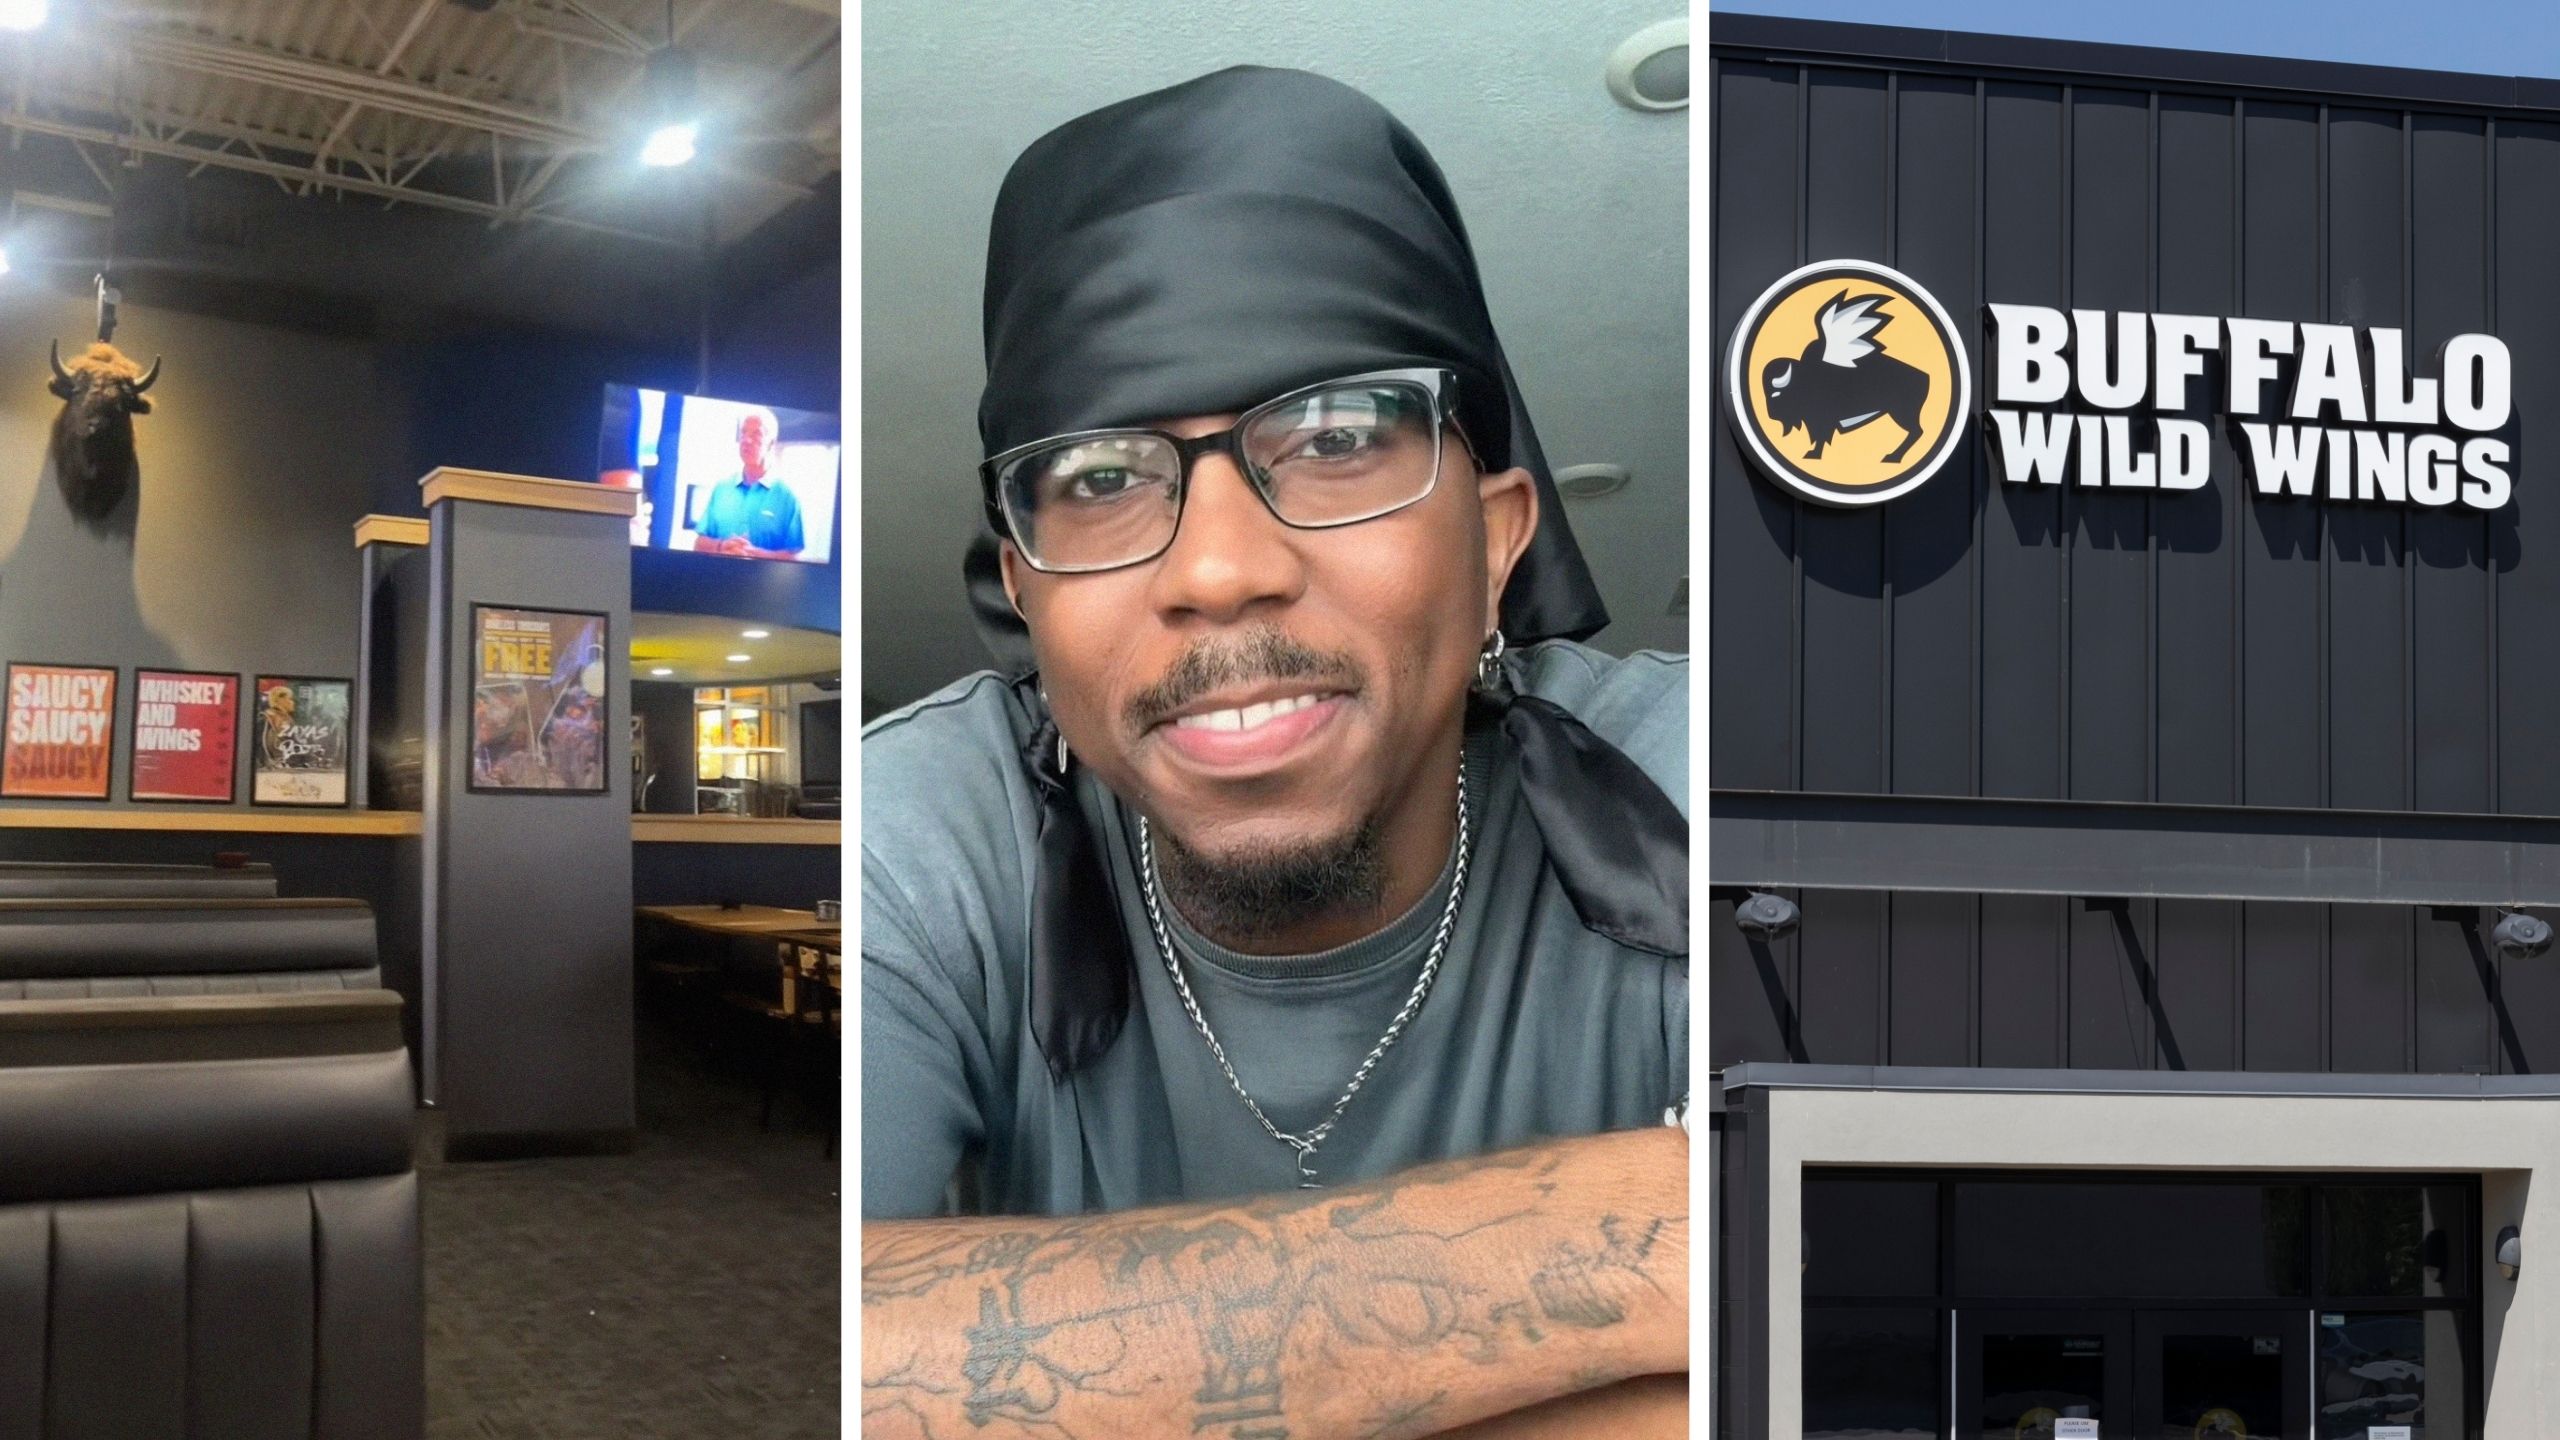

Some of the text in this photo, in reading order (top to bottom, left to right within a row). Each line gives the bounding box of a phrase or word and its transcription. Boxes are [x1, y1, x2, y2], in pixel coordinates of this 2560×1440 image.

[1988, 302, 2511, 431] BUFFALO
[1988, 409, 2511, 509] WILD WINGS
[485, 642, 552, 674] FREE
[12, 673, 108, 709] SAUCY
[139, 679, 226, 705] WHISKEY
[10, 709, 106, 745] SAUCY
[137, 703, 177, 727] AND
[136, 727, 202, 752] WINGS
[9, 745, 105, 780] SAUCY
